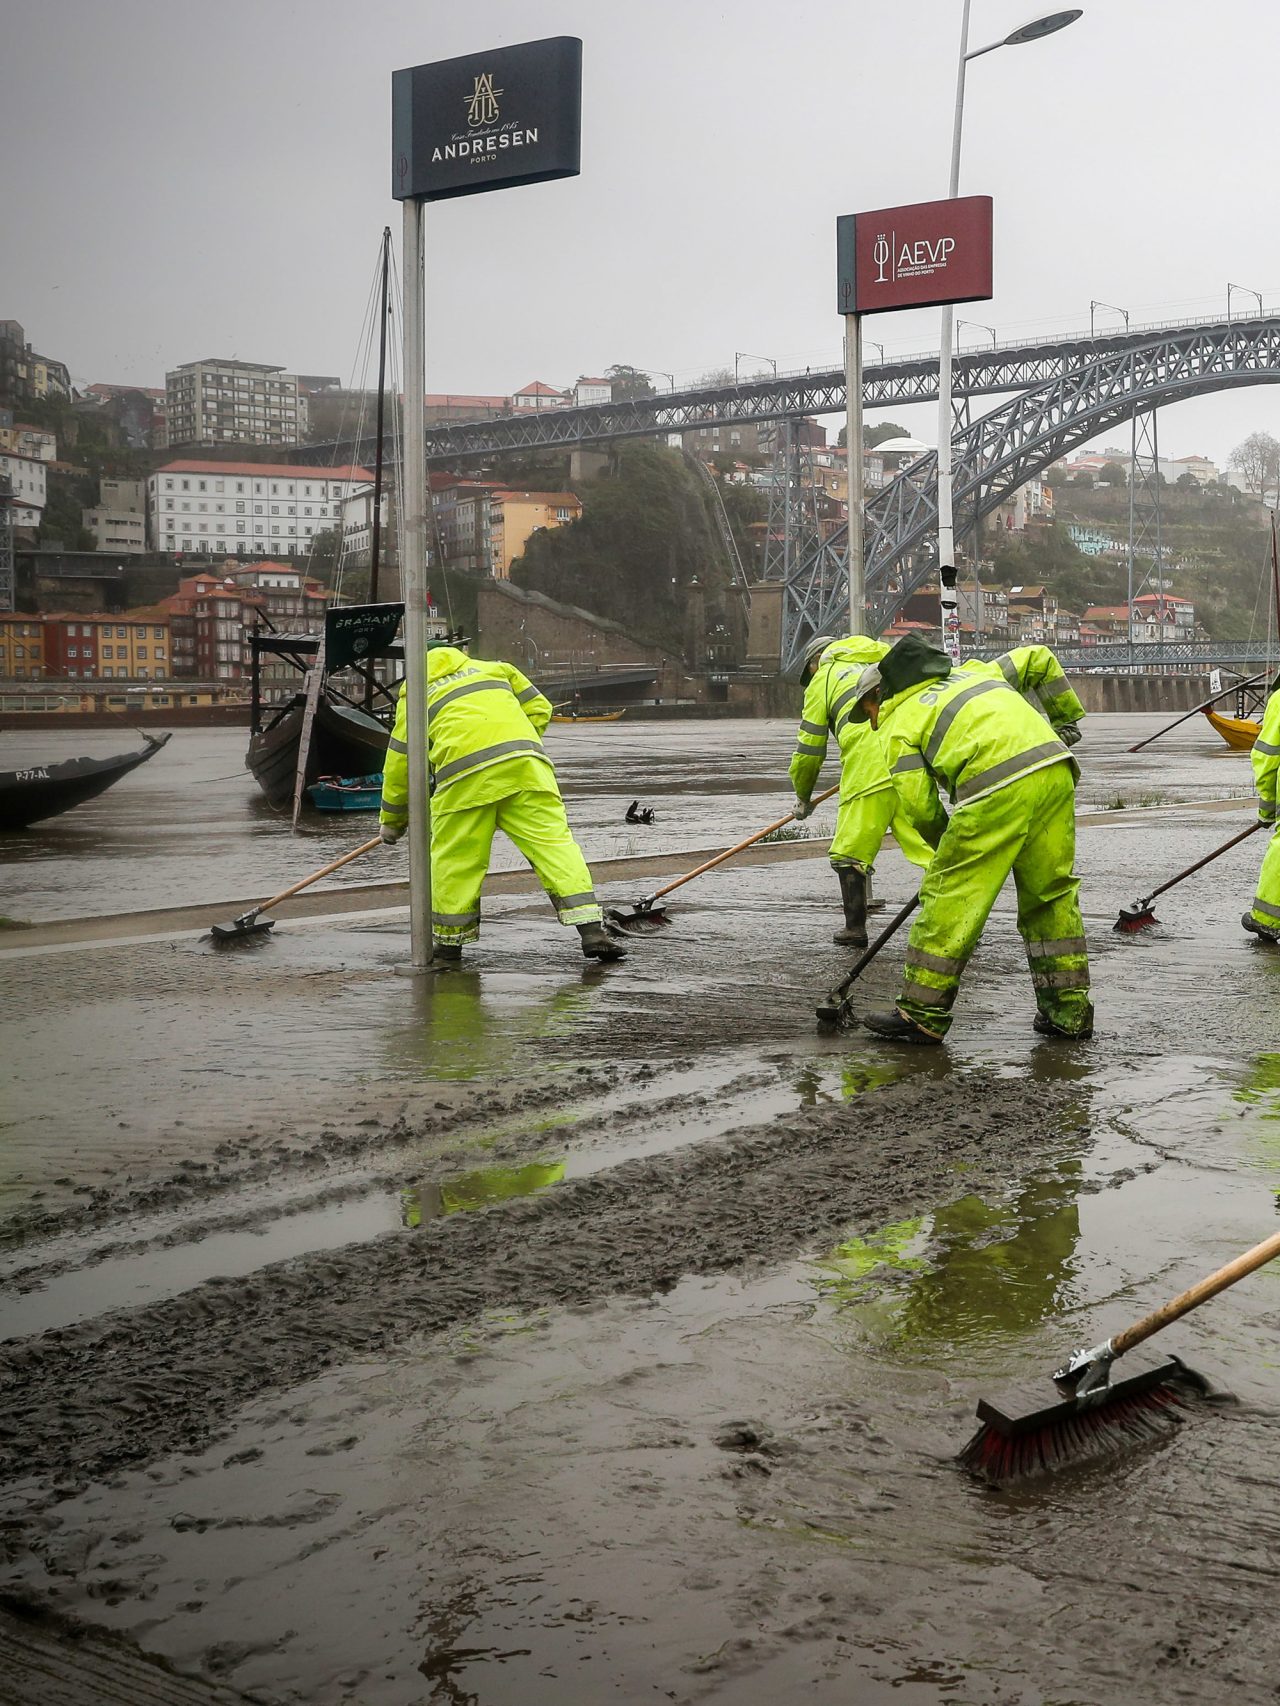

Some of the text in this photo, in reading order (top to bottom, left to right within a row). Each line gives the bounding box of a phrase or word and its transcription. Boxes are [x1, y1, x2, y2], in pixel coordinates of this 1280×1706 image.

[431, 128, 539, 162] ANDRESEN
[470, 154, 497, 164] PORTO
[897, 238, 955, 267] AEVP
